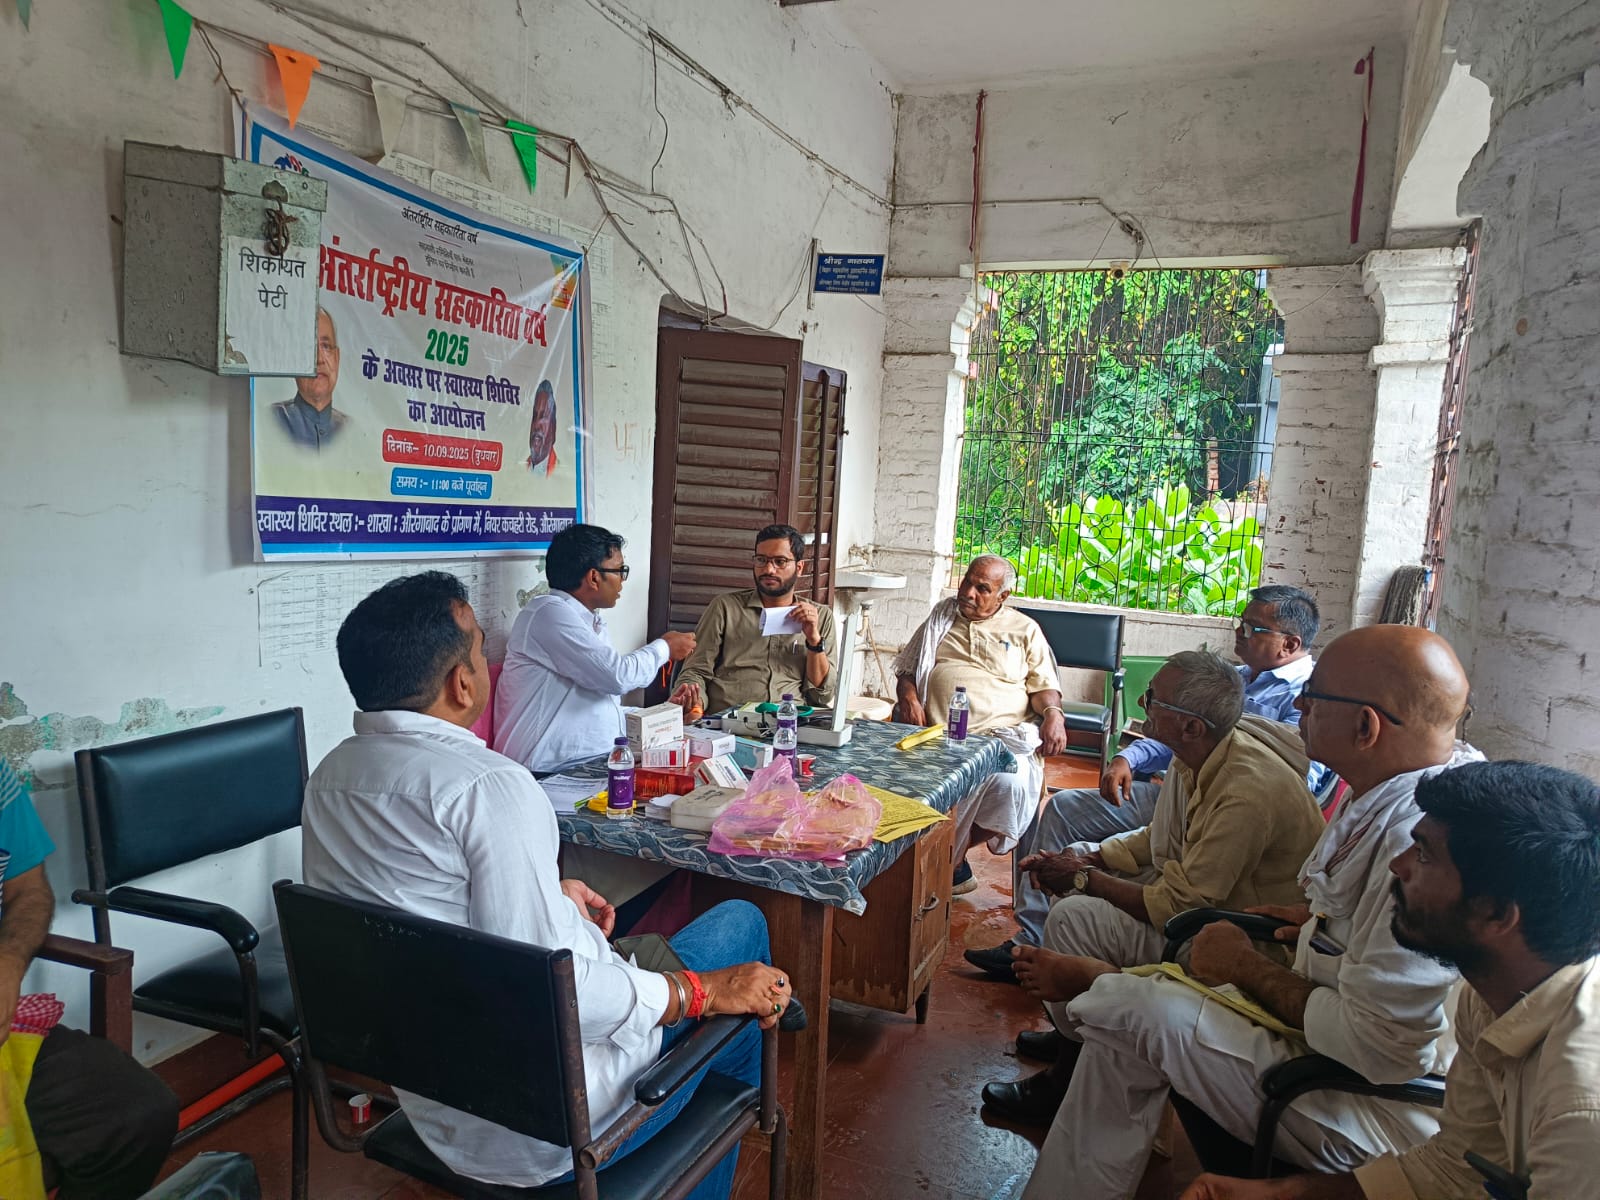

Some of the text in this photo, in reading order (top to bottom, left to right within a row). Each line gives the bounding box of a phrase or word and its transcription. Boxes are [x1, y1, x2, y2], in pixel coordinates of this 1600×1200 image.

[467, 231, 479, 245] वर्ष
[238, 246, 307, 279] शिकायत
[257, 282, 288, 310] पेटी
[434, 286, 523, 341] सहकारिता
[523, 303, 548, 348] वर्ष
[424, 328, 471, 367] 2025
[361, 348, 521, 406] के अवसर पर स्वास्थ्य शिविर
[406, 399, 486, 432] का आयोजन
[423, 443, 469, 461] 10.09.2025
[395, 475, 418, 489] समय
[431, 478, 449, 491] 11:00
[451, 476, 464, 492] बजे
[257, 509, 296, 532] स्वास्थ्य
[297, 503, 328, 533] शिविर
[329, 512, 353, 533] स्थल
[367, 513, 393, 533] शाखा
[400, 507, 440, 534] औरंगाबाद
[440, 509, 451, 534] के
[451, 508, 473, 536] प्रांगण
